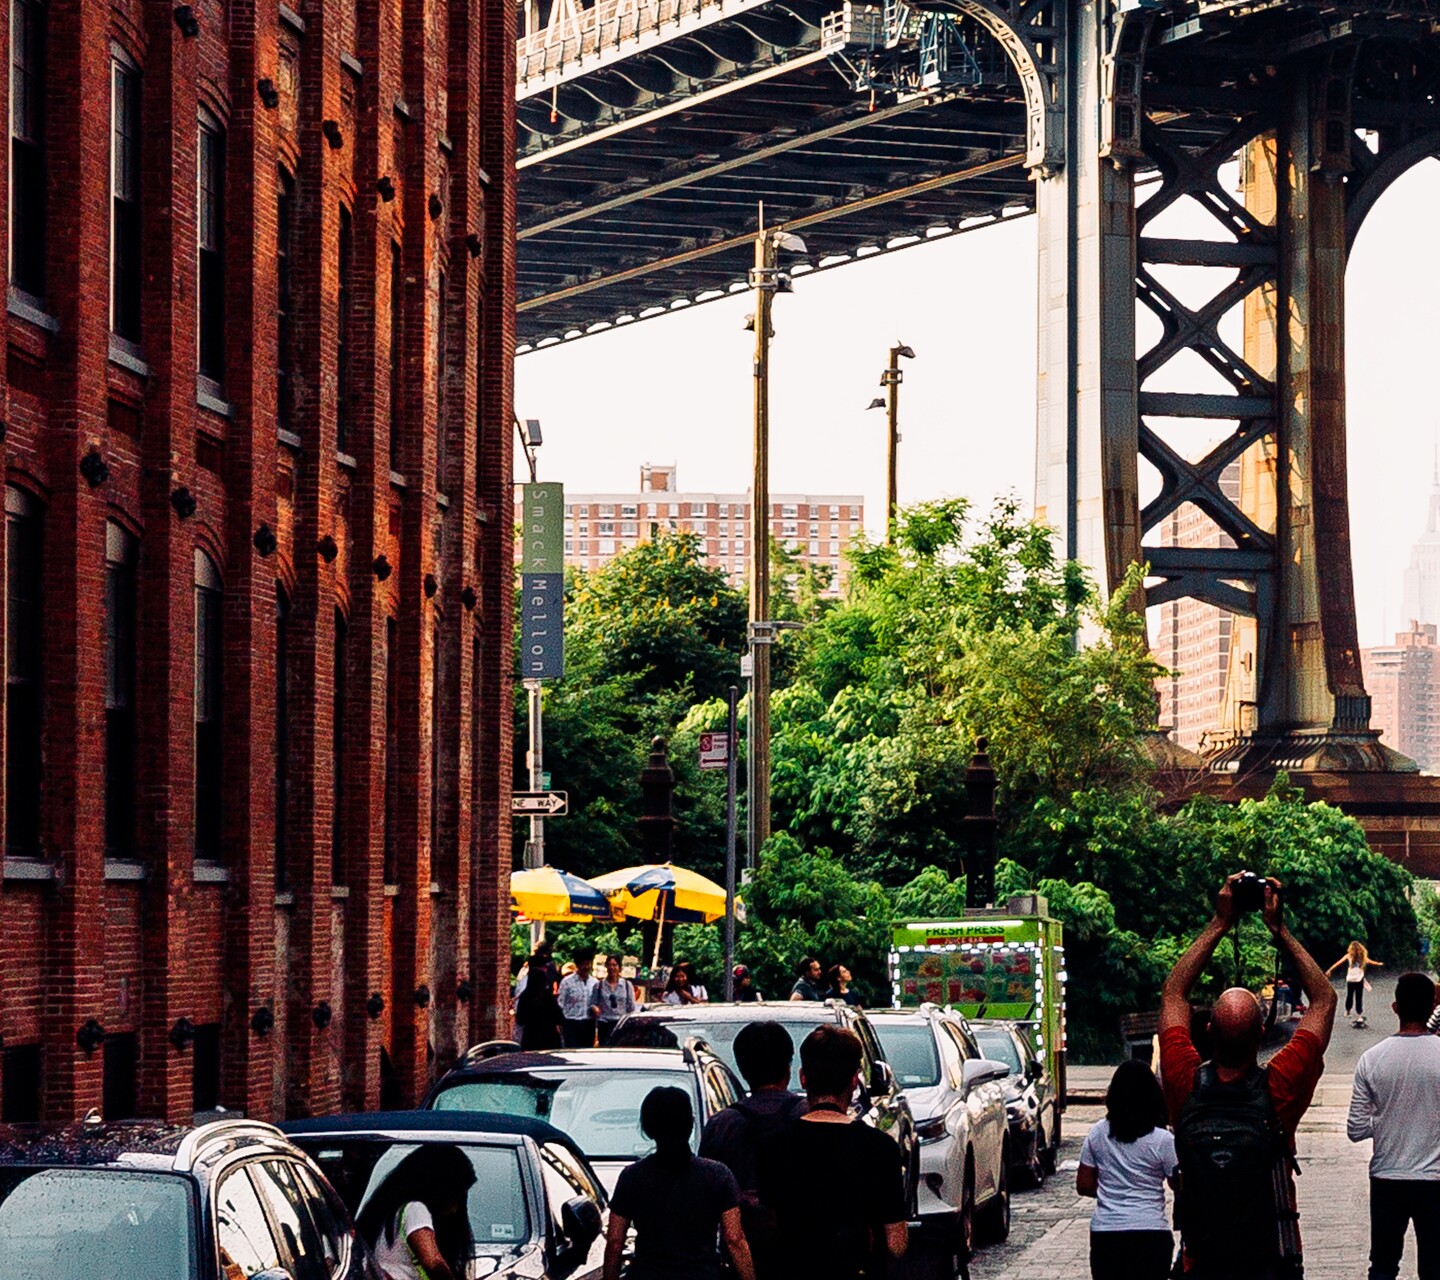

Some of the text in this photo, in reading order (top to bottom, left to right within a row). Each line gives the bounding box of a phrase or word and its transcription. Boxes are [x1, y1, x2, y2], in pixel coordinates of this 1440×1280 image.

[531, 490, 547, 671] Smack Mellon
[536, 799, 558, 807] WAY
[926, 926, 1005, 936] FRESH PRESS
